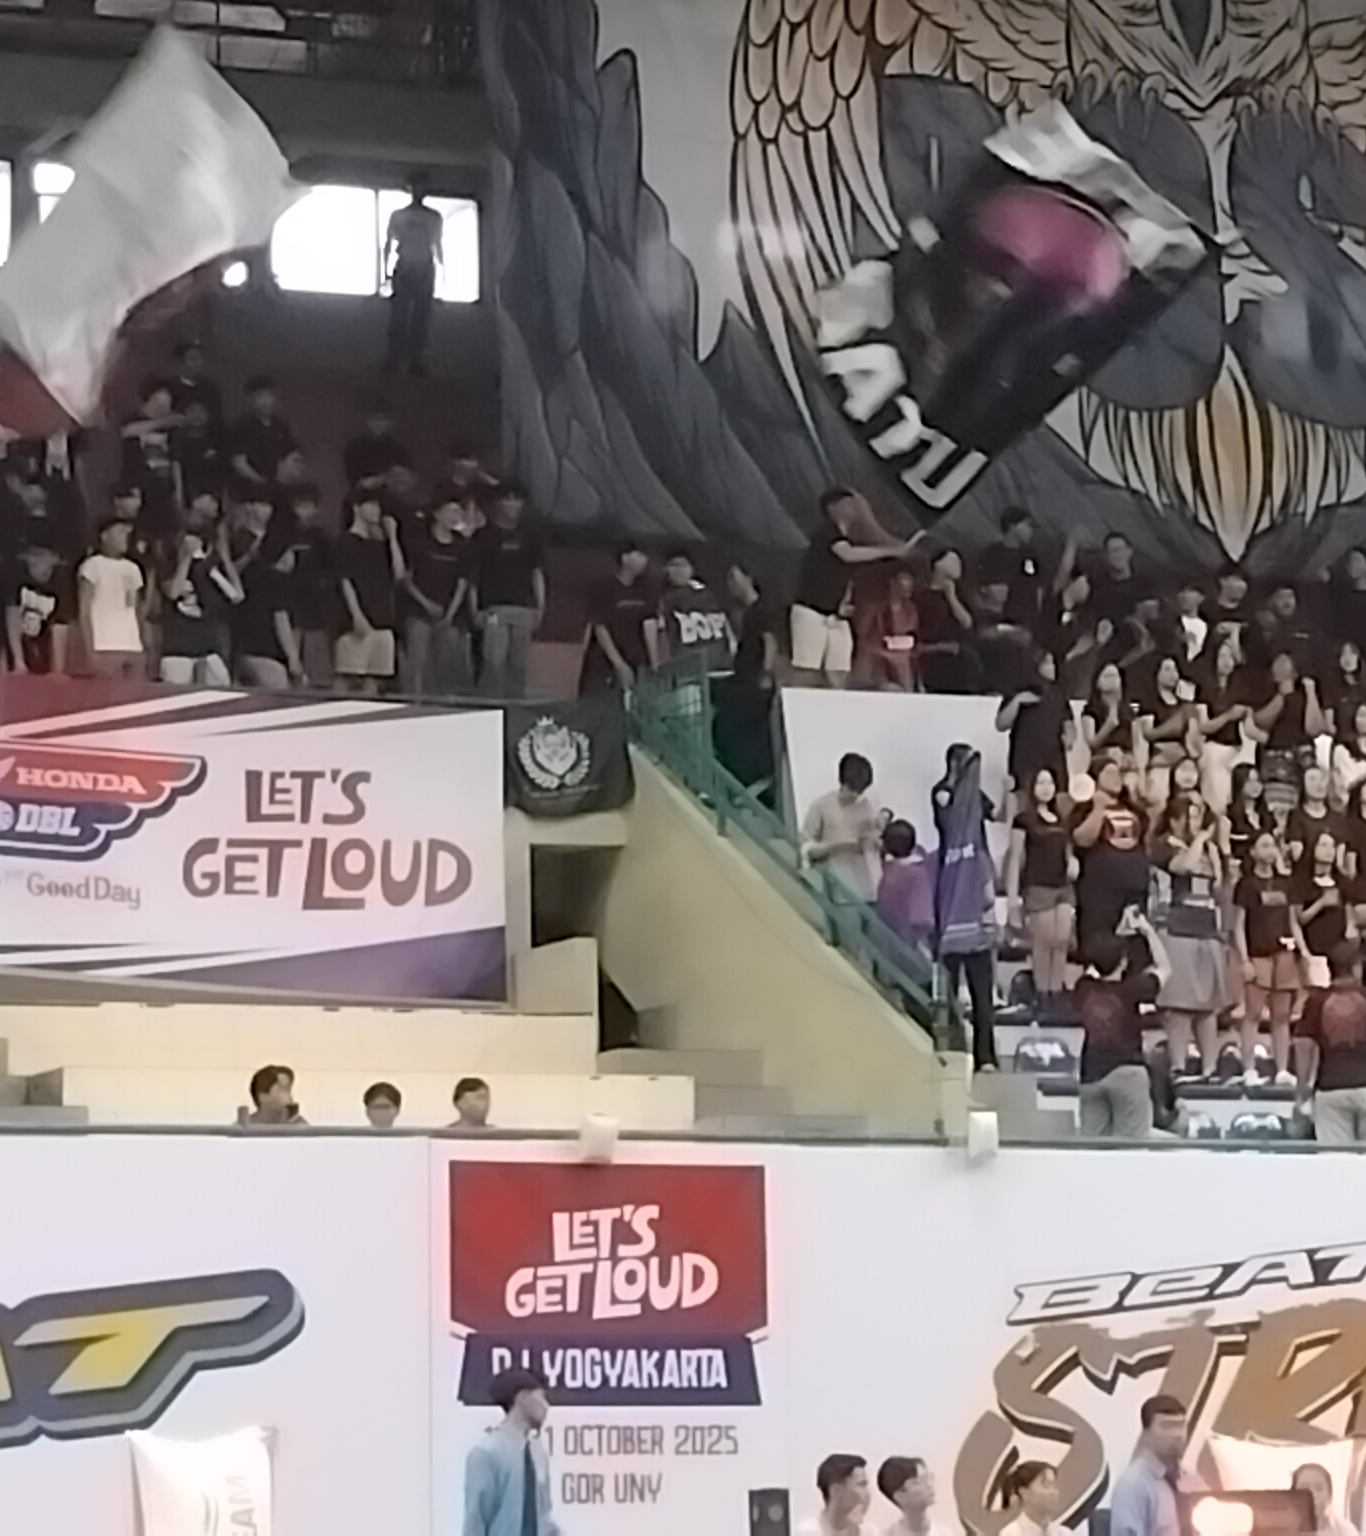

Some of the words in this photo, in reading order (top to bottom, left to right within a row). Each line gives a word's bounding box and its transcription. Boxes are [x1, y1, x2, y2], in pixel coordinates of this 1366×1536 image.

[15, 766, 148, 796] HONDA
[244, 768, 372, 825] LET'S
[14, 803, 82, 837] DBL
[182, 837, 303, 898] GET
[302, 837, 472, 911] LOUD
[552, 1203, 660, 1263] LET'S
[505, 1263, 594, 1318] GET
[592, 1252, 720, 1321] LOUD
[564, 1424, 665, 1457] OCTOBER
[675, 1424, 740, 1456] 2025
[561, 1471, 605, 1506] GOR
[614, 1471, 663, 1505] UNY
